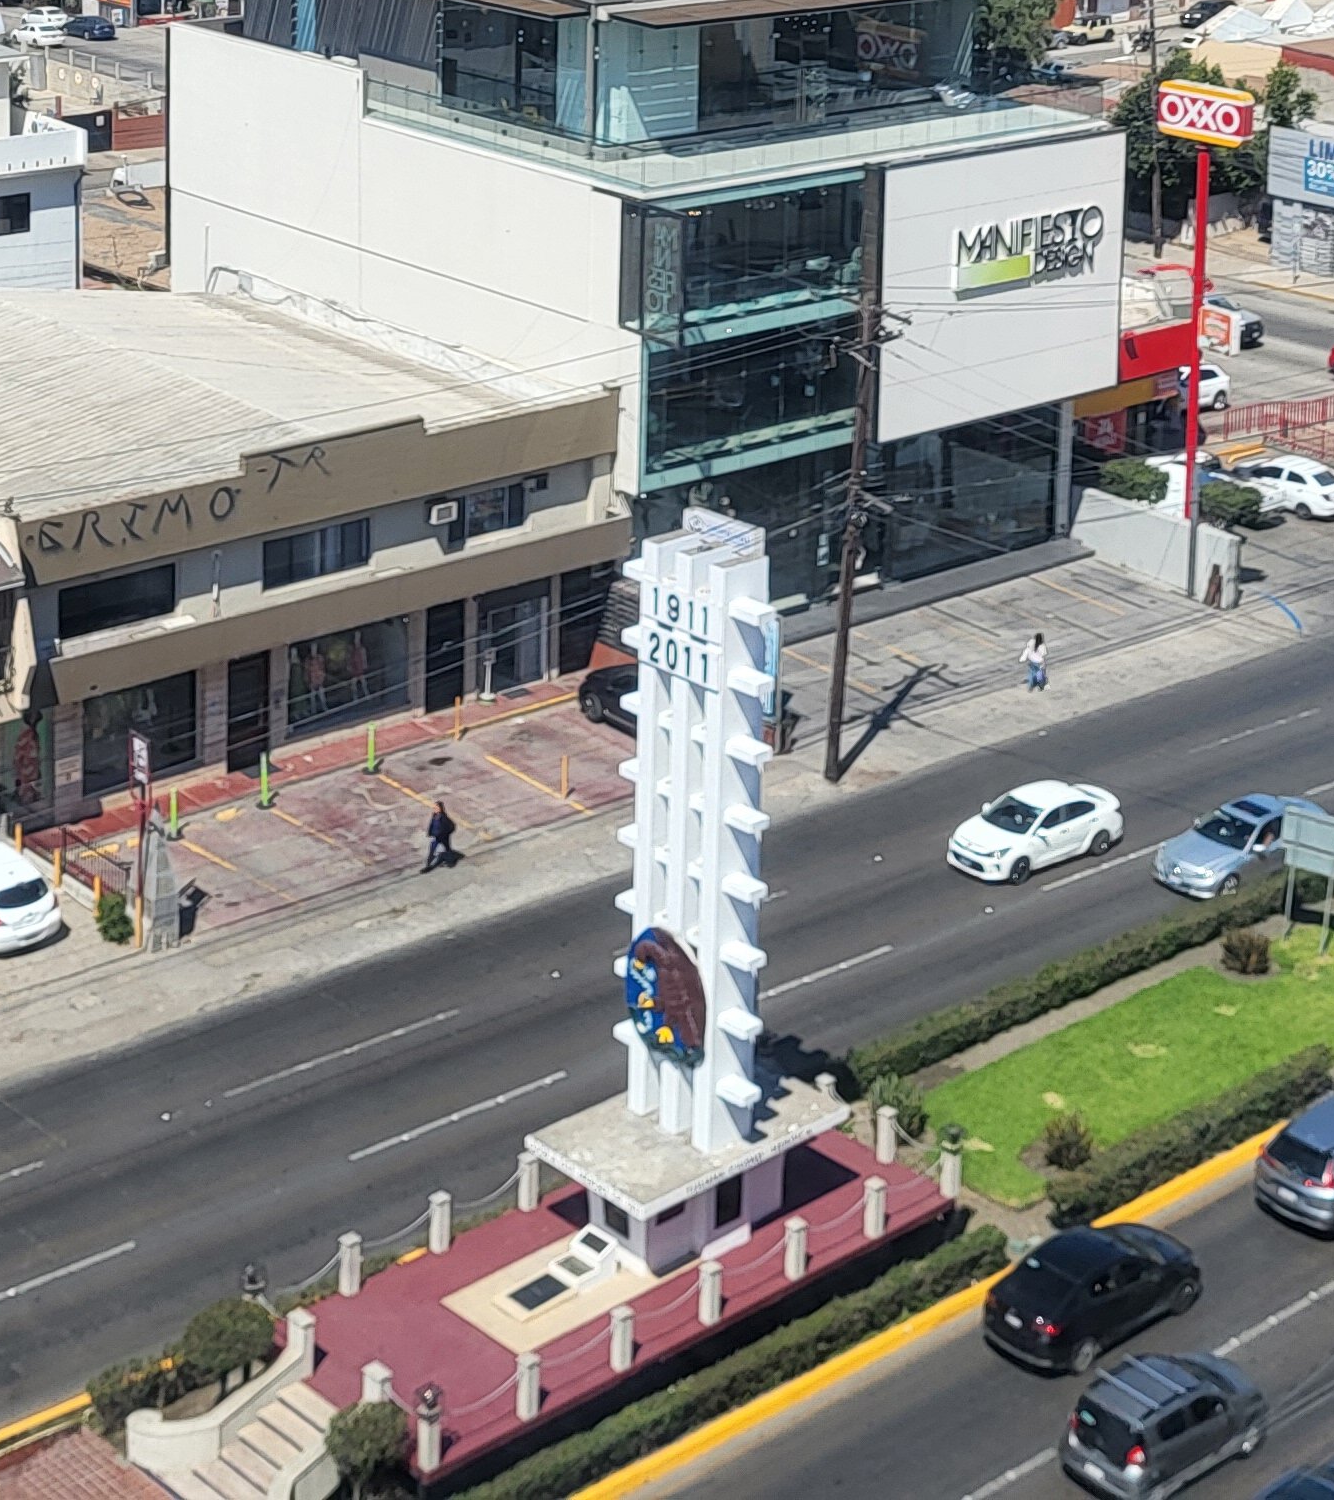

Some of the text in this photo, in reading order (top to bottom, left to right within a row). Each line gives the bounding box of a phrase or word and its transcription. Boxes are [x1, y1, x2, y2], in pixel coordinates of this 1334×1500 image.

[1160, 94, 1241, 135] OXXO
[956, 205, 1104, 268] MANIFIESTO
[1034, 241, 1096, 276] DESIGN
[653, 586, 709, 636] 1911
[649, 632, 709, 684] 2011
